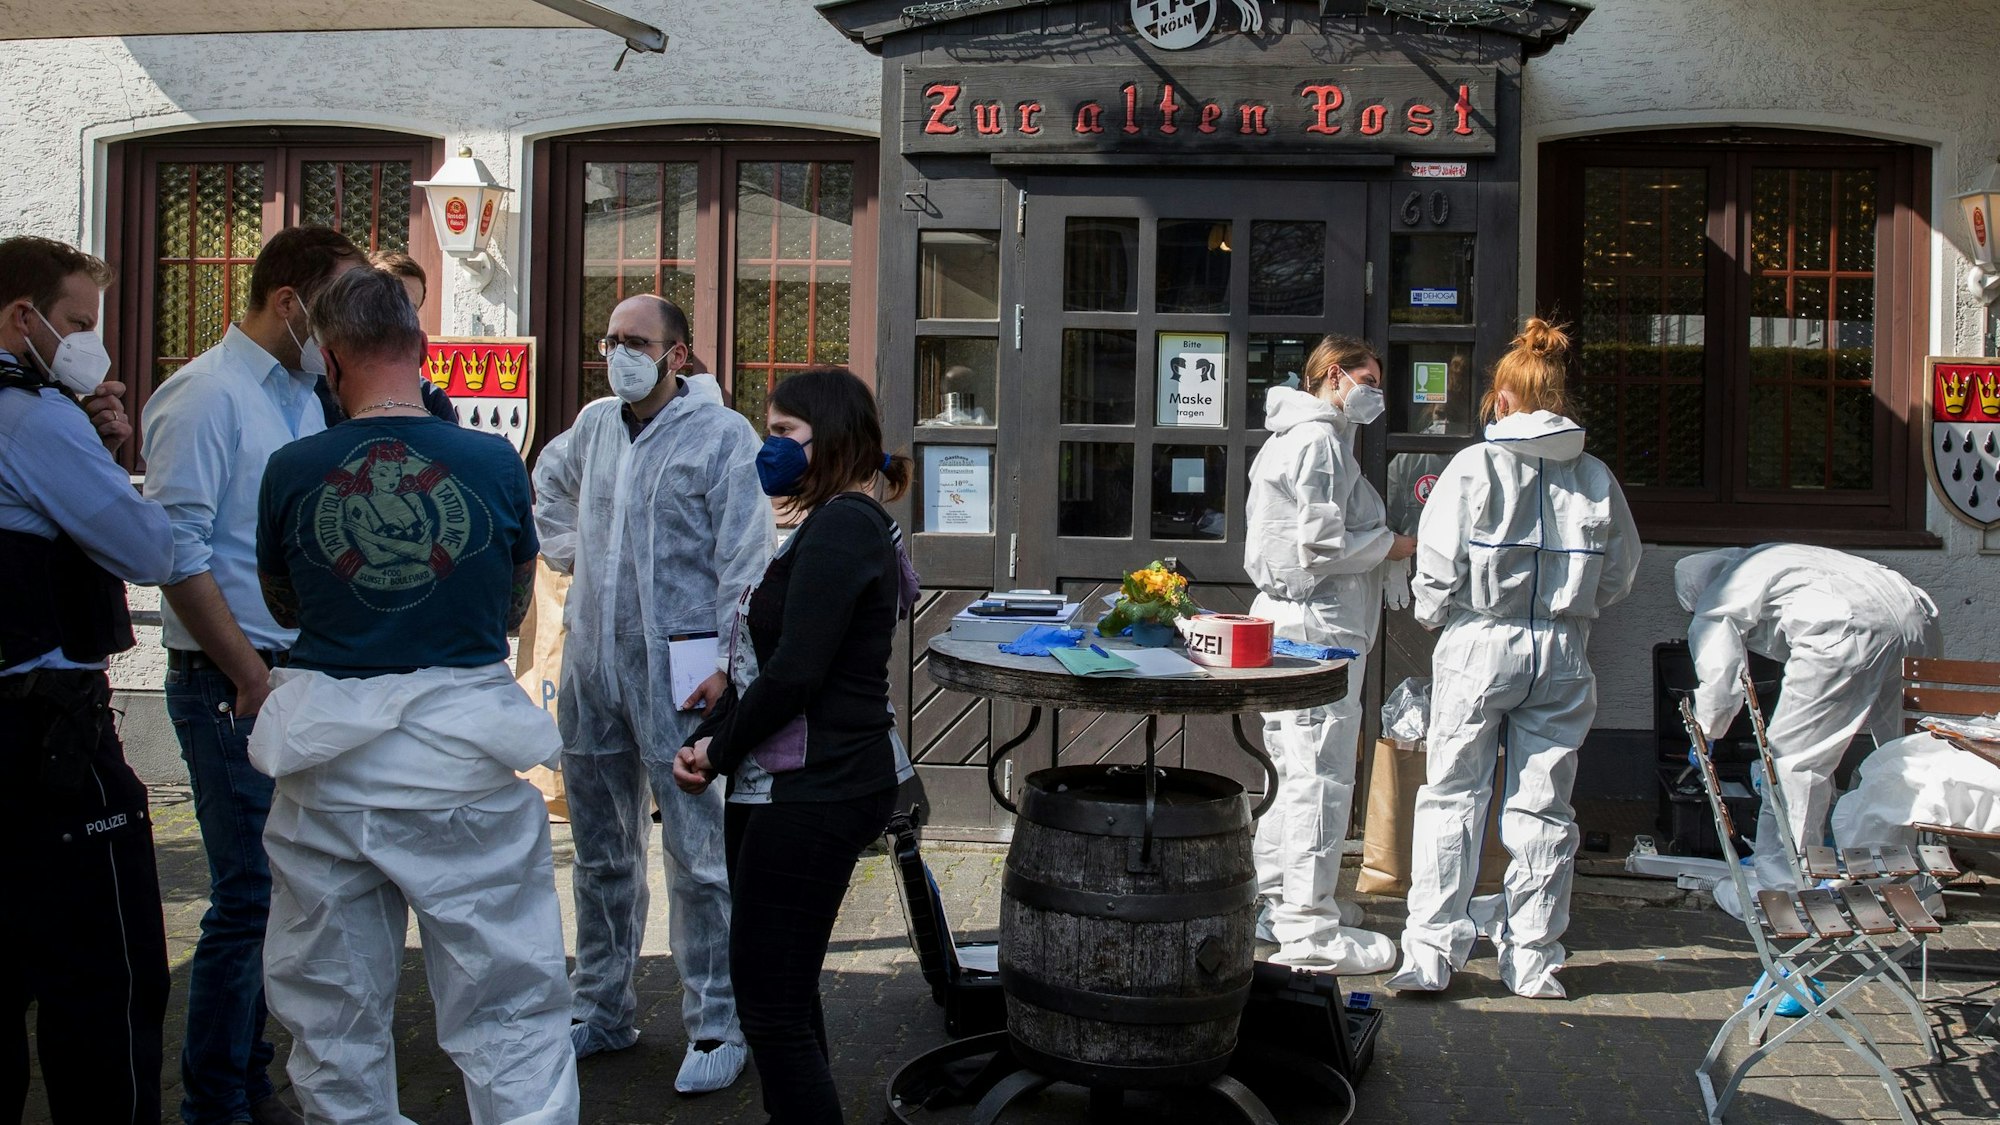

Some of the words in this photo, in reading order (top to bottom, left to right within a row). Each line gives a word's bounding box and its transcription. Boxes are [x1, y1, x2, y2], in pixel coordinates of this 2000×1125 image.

[1160, 13, 1192, 36] KÖLN
[924, 84, 1041, 134] Zur
[1075, 84, 1268, 134] alten
[1301, 84, 1472, 135] Post
[1401, 189, 1448, 225] 60
[1423, 292, 1455, 300] DEHOGA
[1183, 340, 1201, 348] Bitte
[1169, 393, 1212, 405] Maske
[1176, 409, 1204, 418] tragen
[320, 492, 341, 514] YOU
[436, 483, 465, 523] TATTOO
[319, 516, 345, 557] TATTOO
[440, 527, 465, 550] ME
[359, 572, 386, 585] SUNSET
[390, 570, 430, 586] BOULEVARD
[381, 569, 401, 577] 4000
[86, 813, 127, 835] POLIZEI
